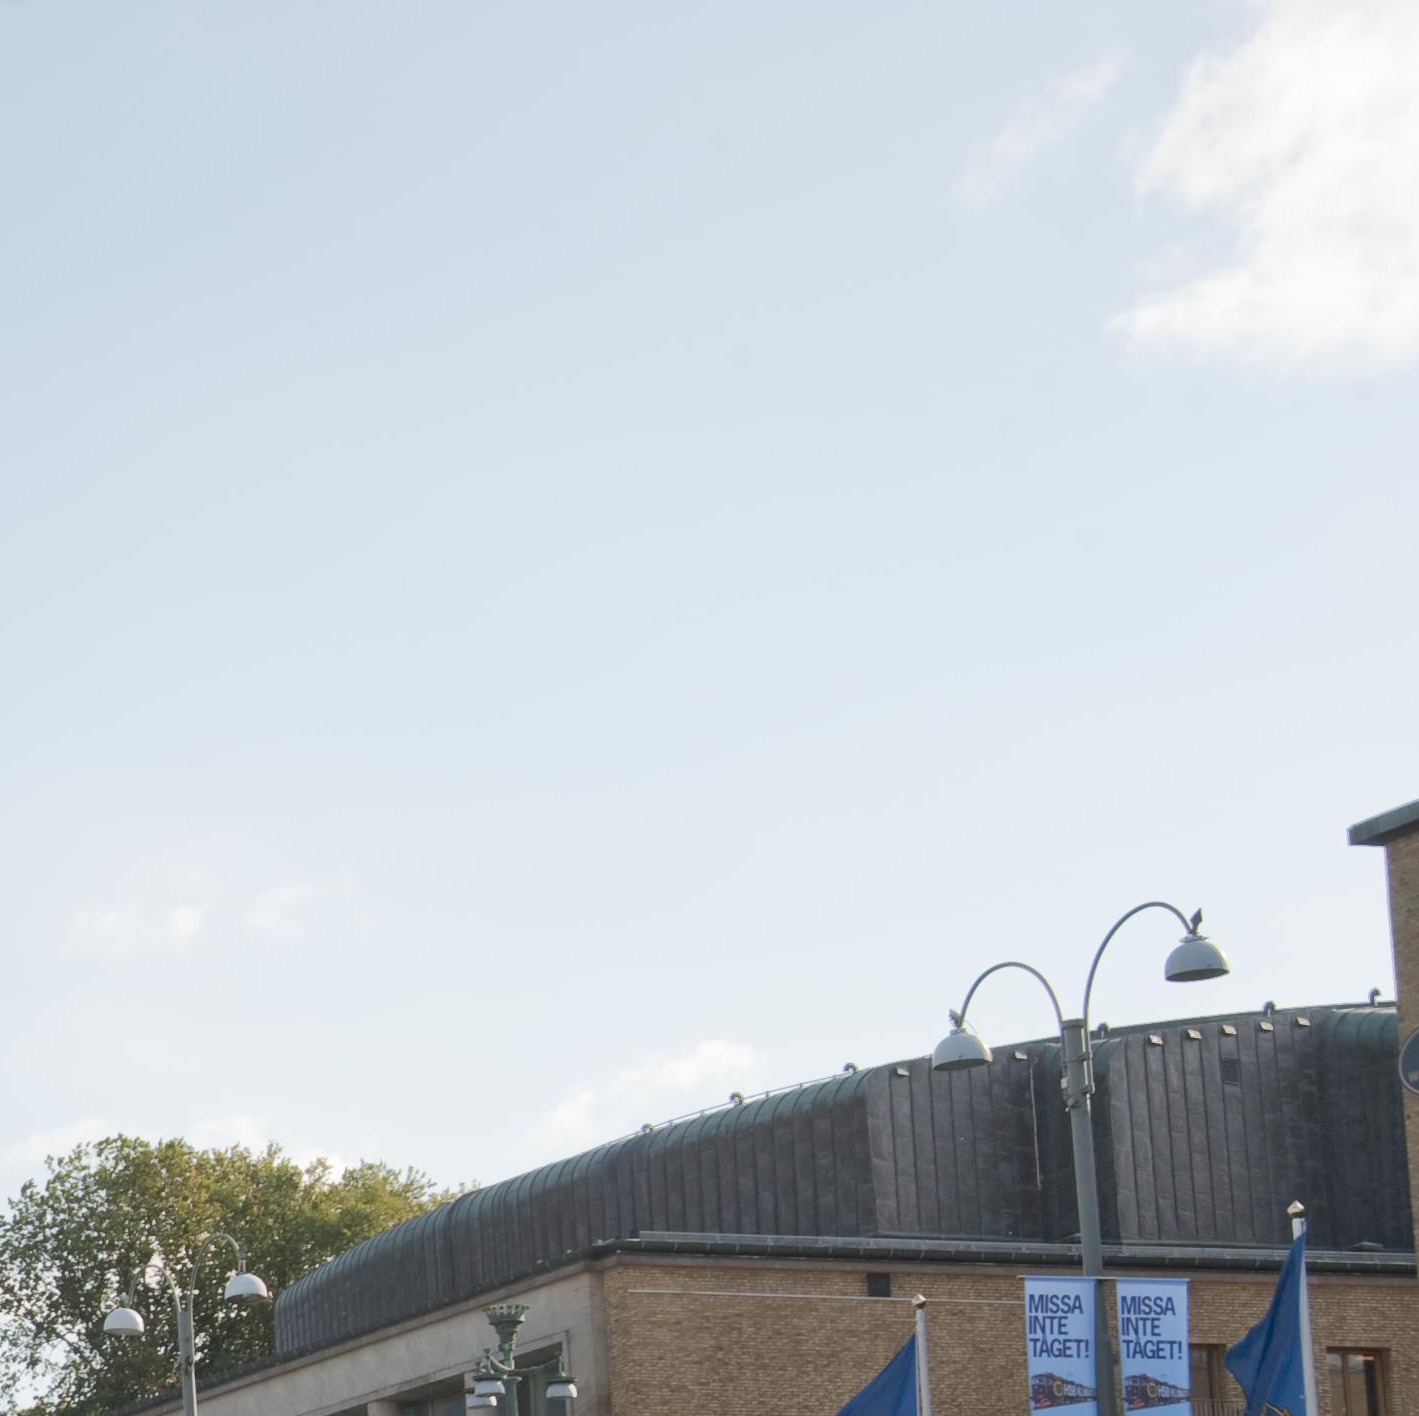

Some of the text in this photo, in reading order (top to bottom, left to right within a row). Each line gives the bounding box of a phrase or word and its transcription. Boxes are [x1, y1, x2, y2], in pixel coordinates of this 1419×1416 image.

[1028, 1294, 1083, 1315] MISSA
[1121, 1296, 1176, 1316] MISSA
[1028, 1316, 1069, 1336] INTE
[1121, 1317, 1162, 1337] INTE
